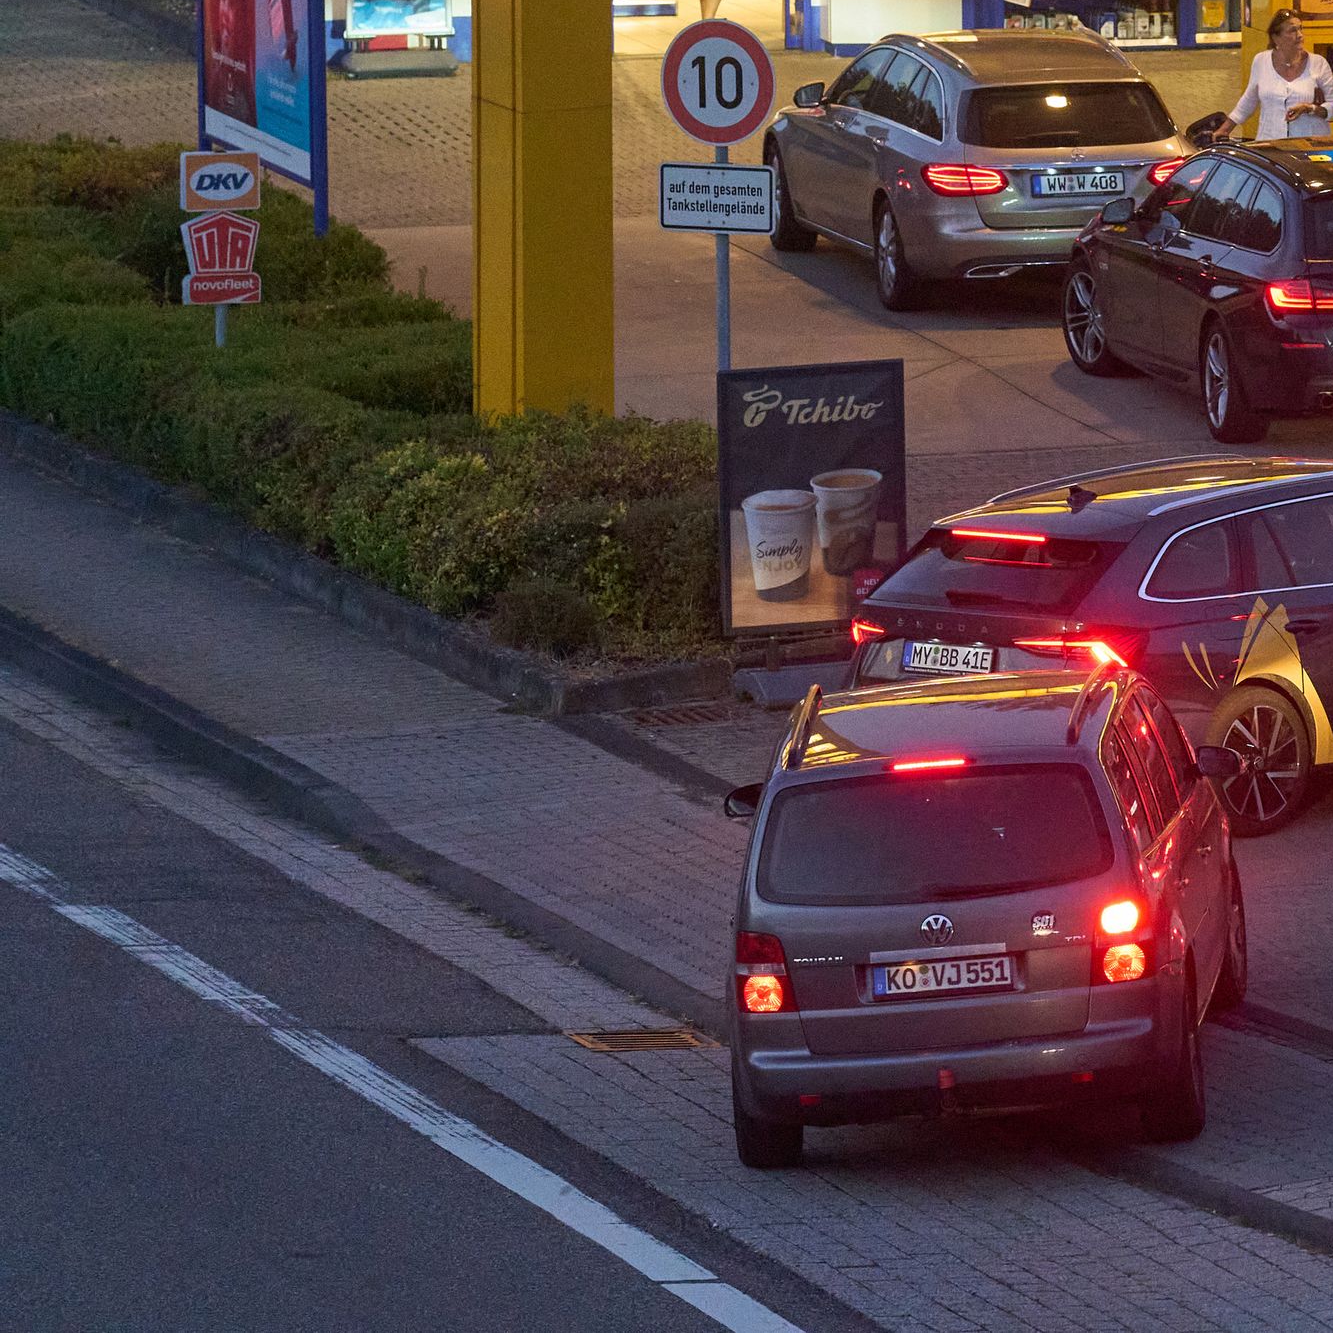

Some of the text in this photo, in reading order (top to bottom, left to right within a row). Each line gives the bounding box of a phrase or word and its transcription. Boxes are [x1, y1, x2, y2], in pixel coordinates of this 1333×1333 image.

[691, 55, 743, 110] 10
[195, 172, 250, 191] DKV
[669, 180, 763, 199] auf dem gesamten
[1047, 175, 1118, 191] WW W 408
[667, 197, 765, 216] Tankstellengelände
[193, 220, 254, 272] UTA
[193, 278, 255, 291] novofleet
[782, 396, 884, 425] Tchibo
[756, 538, 803, 560] Simply
[912, 645, 991, 671] MY BB 41E
[887, 959, 1009, 991] KO VJ 551
